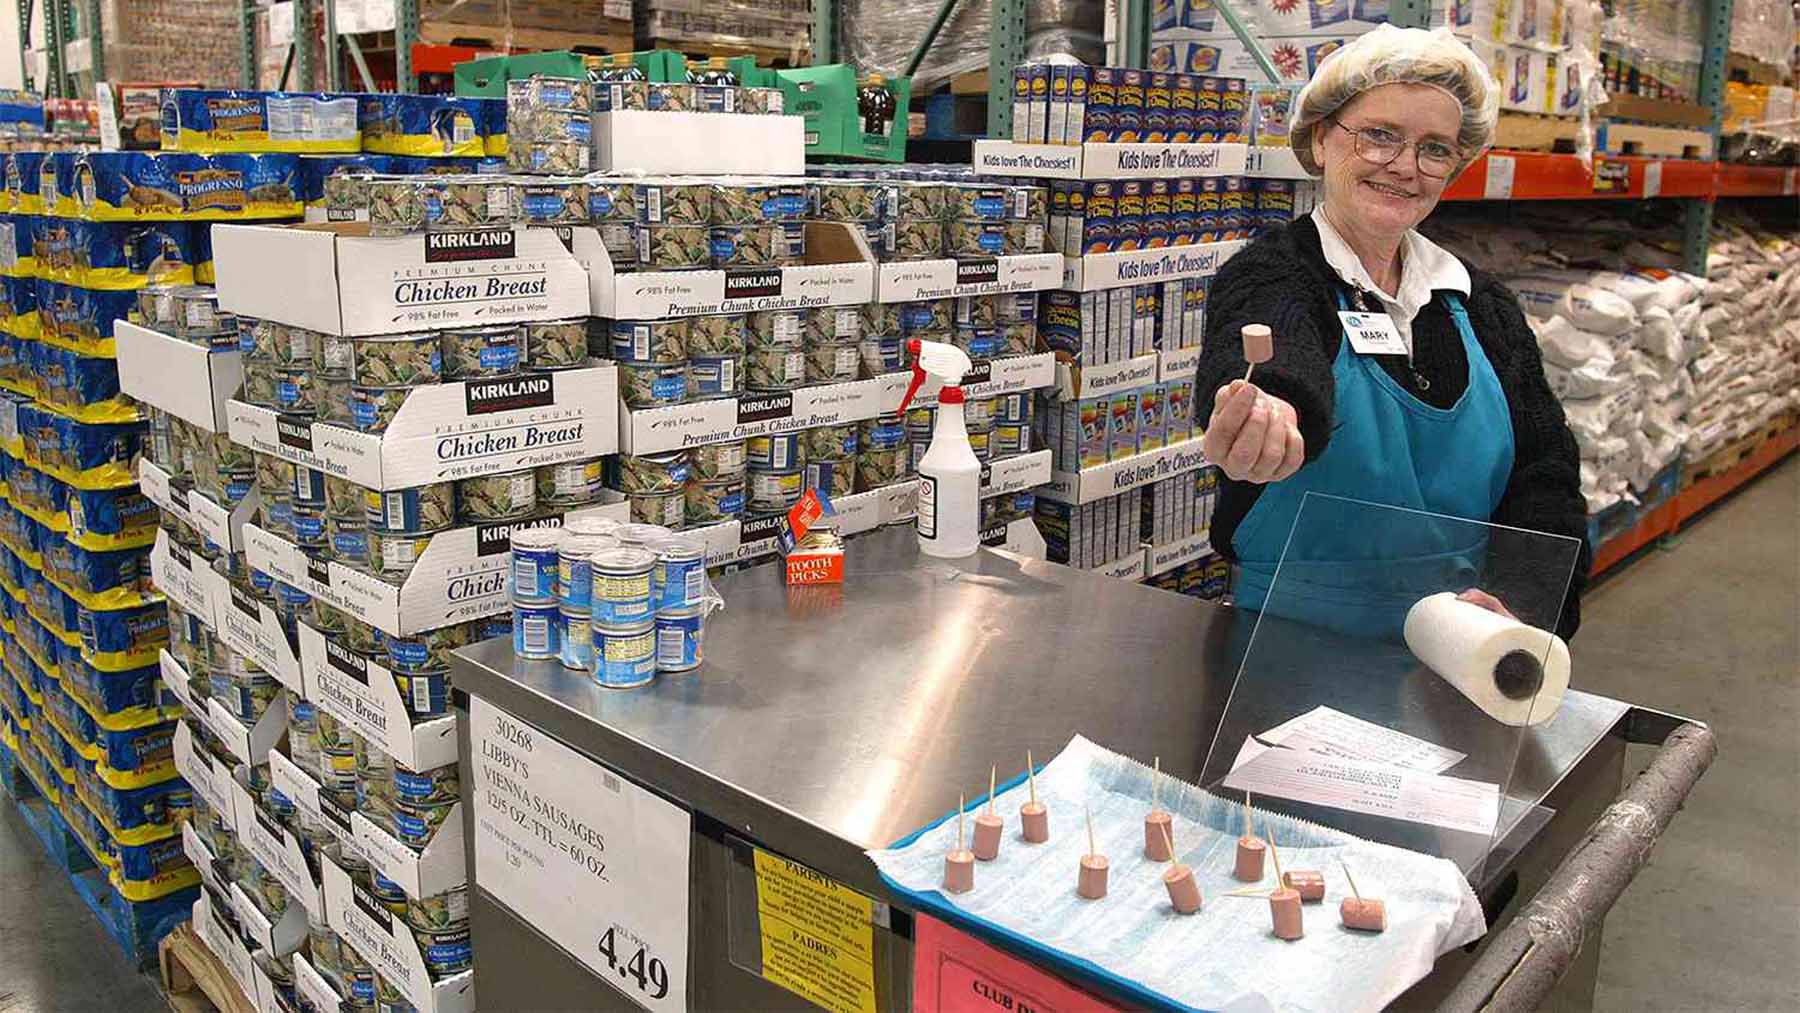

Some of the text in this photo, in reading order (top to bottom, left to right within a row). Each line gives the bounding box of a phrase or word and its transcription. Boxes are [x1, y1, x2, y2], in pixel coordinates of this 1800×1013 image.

[983, 155, 1001, 166] Kids
[1001, 156, 1018, 167] love
[1018, 154, 1033, 167] The
[1118, 153, 1139, 169] Kids
[1141, 152, 1160, 170] love
[1161, 149, 1176, 168] The
[179, 179, 243, 195] PROGRESSO
[430, 232, 512, 248] KIRKLAND
[959, 264, 997, 275] KIRKLAND
[1118, 259, 1139, 280] Kids
[1140, 258, 1159, 278] love
[1161, 253, 1176, 274] The
[395, 277, 546, 303] Chicken Breast
[728, 276, 780, 288] KIRKLAND
[668, 295, 830, 315] Premium Chunk Chicken Breast
[1360, 330, 1390, 340] MARY
[470, 379, 550, 400] KIRKLAND
[740, 397, 791, 414] KIRKLAND
[438, 423, 583, 459] Chicken Breast
[683, 412, 839, 447] Premium Chunk Chicken Breast
[450, 466, 468, 477] 98%
[470, 464, 482, 474] Fat
[1113, 457, 1171, 489] Kids love The
[791, 558, 832, 571] TOOTH
[791, 569, 828, 584] PICKS
[447, 574, 504, 600] Chick
[317, 674, 353, 710] Chicken
[355, 697, 388, 730] Breast
[495, 716, 533, 753] 30268
[482, 739, 529, 779] LIBBY'S
[483, 764, 606, 852] VIENNA SAUSAGES
[510, 805, 531, 831] OZ.
[532, 819, 557, 848] TTL
[570, 846, 585, 866] 60
[587, 857, 610, 883] OZ.
[785, 860, 839, 891] PARENTS
[791, 930, 838, 960] PADRES
[598, 927, 669, 1000] 4.49
[973, 980, 1013, 1010] CLUB
